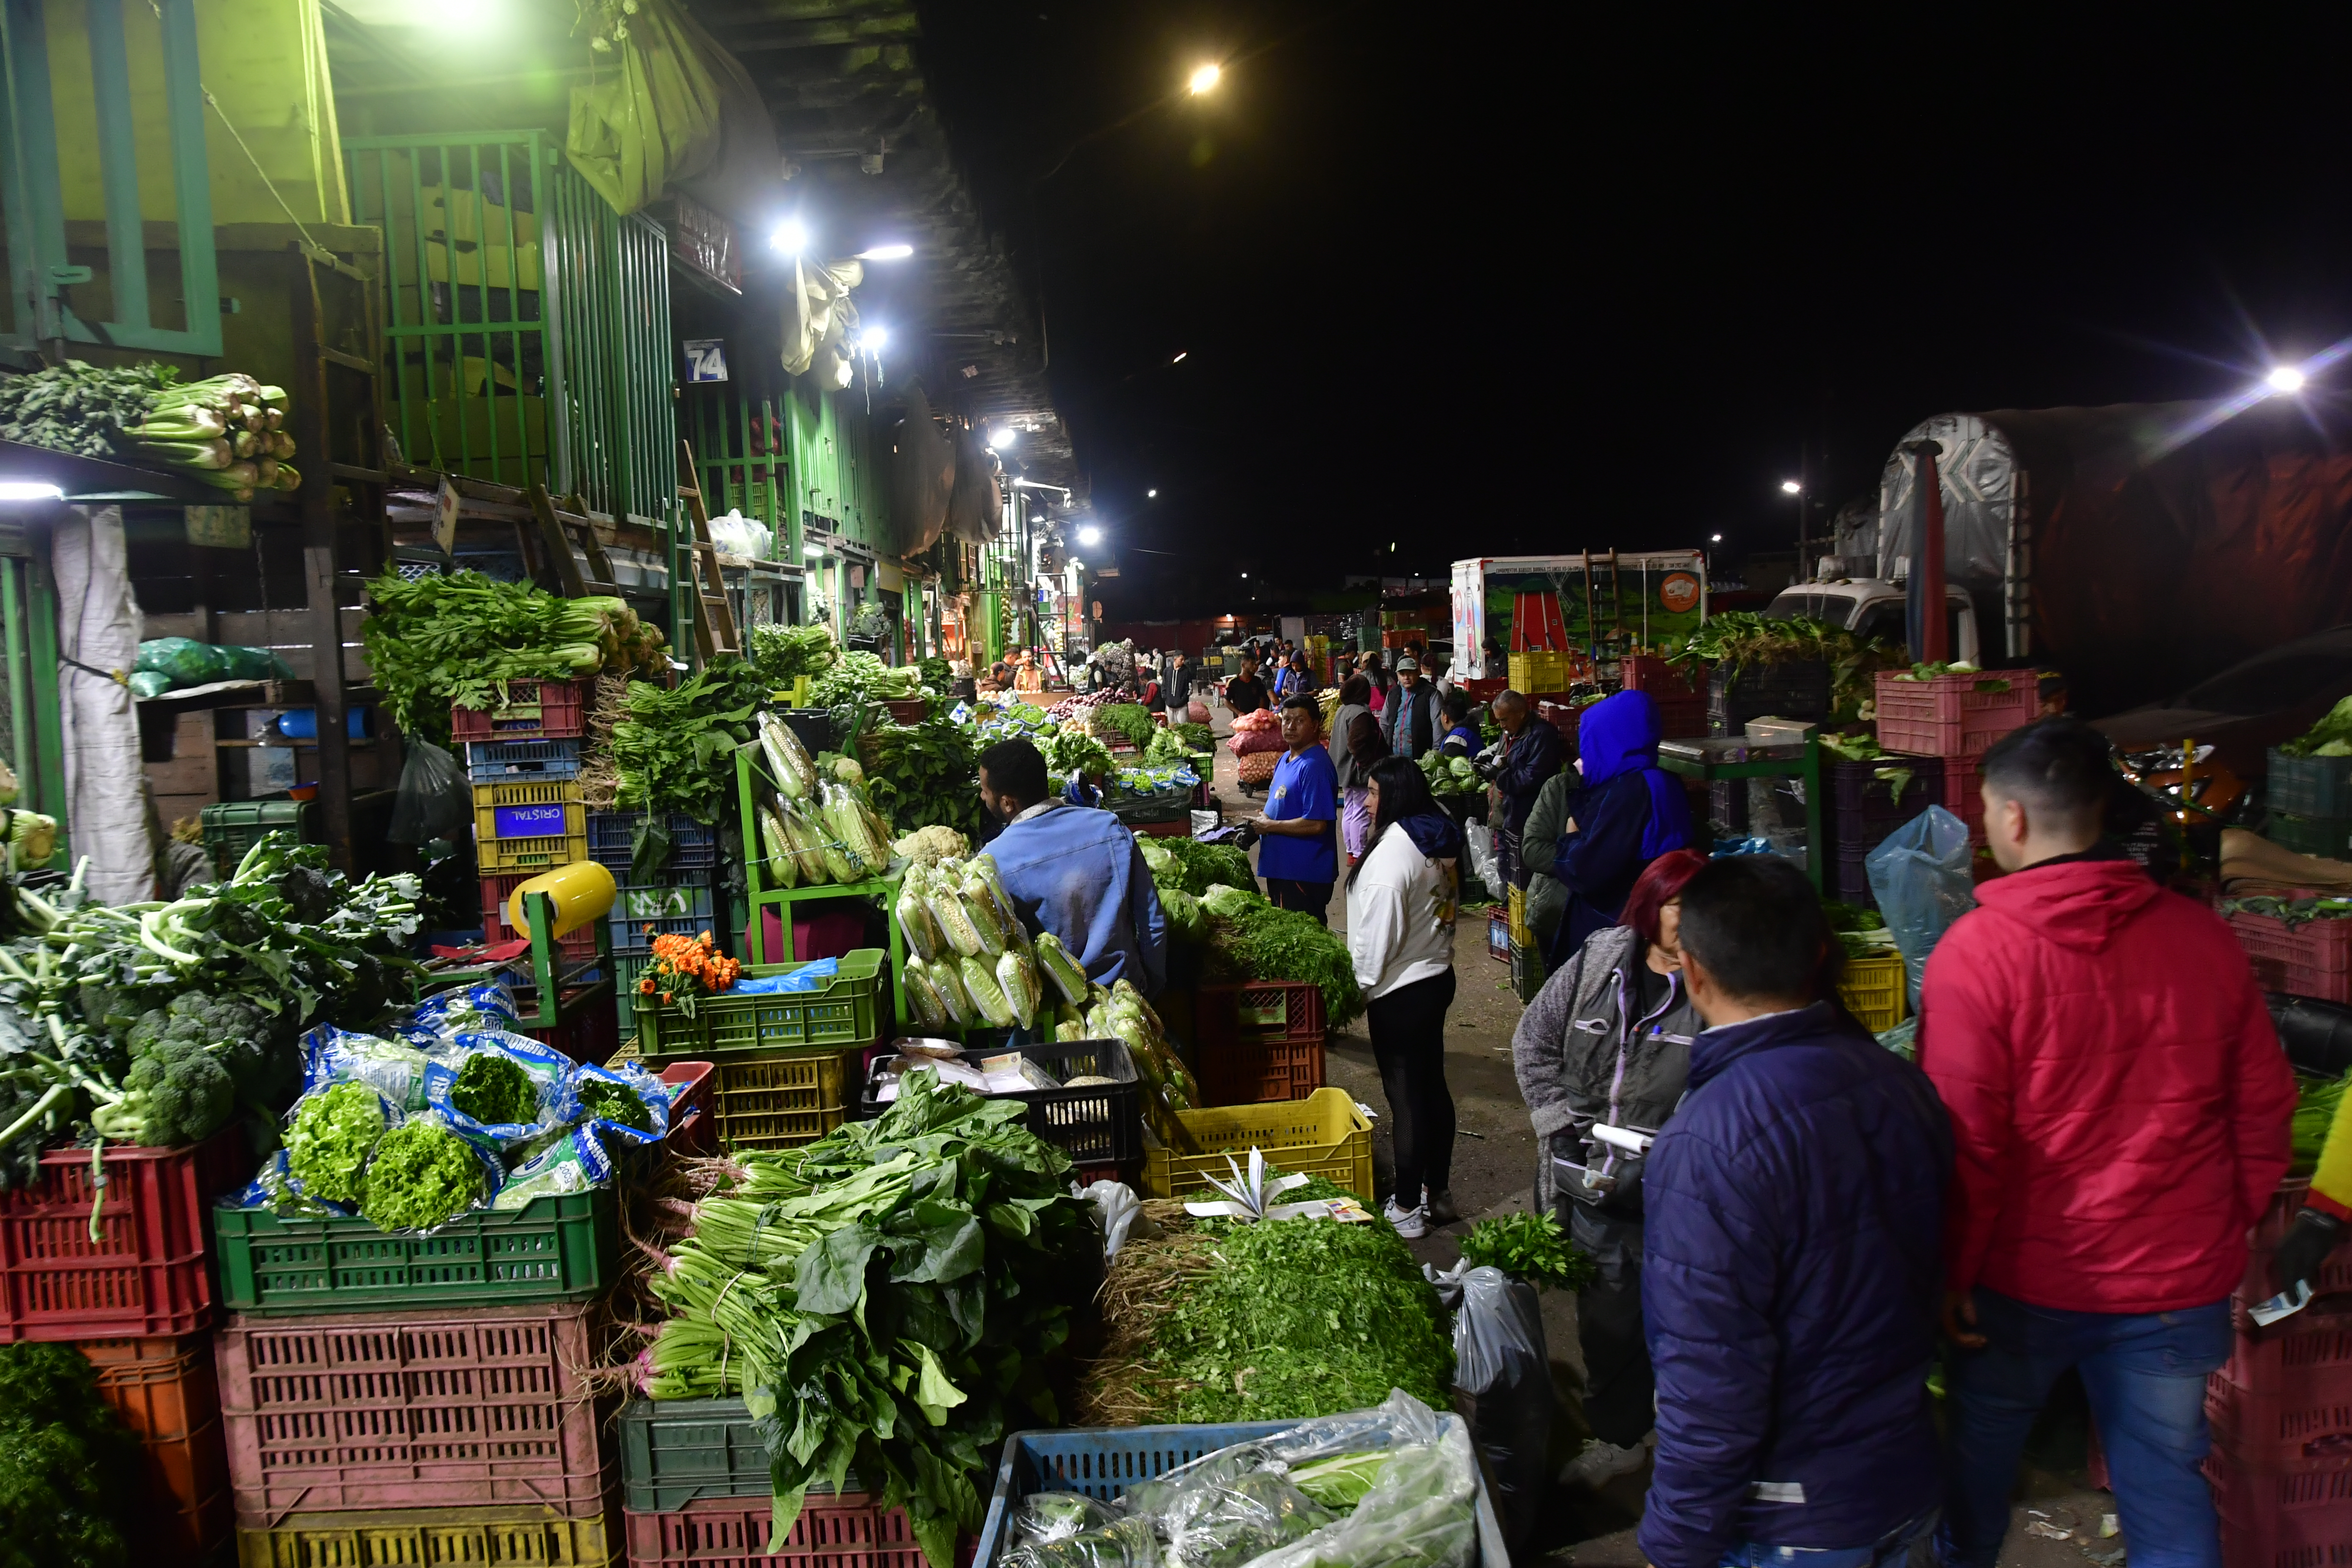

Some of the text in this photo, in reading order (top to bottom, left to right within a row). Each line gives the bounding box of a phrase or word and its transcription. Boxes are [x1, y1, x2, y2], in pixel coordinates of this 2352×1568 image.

[687, 348, 724, 381] 74
[511, 808, 560, 821] CRISTAL
[558, 1164, 573, 1184] 200g
